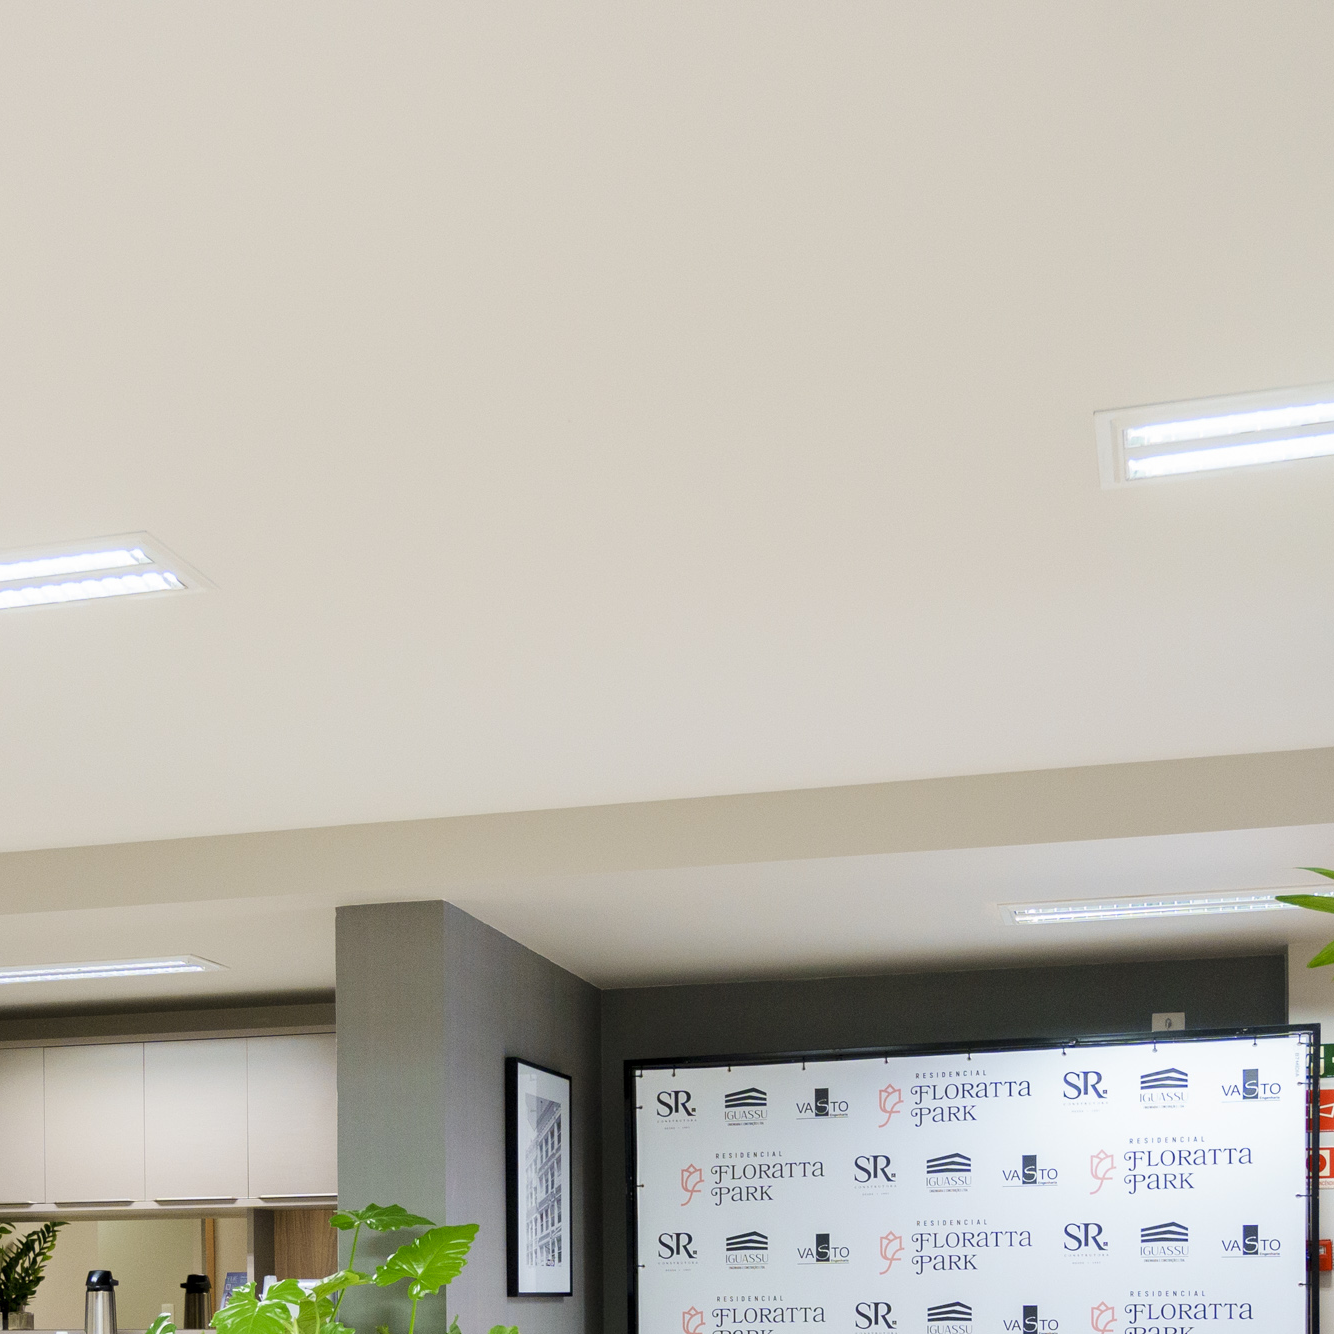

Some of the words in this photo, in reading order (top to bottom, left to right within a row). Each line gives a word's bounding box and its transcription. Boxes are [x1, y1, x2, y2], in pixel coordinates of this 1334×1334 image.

[916, 1070, 986, 1079] RESIDENCIAL
[1063, 1071, 1107, 1100] SR
[1221, 1081, 1281, 1096] VASTO
[657, 1090, 696, 1117] SR
[1140, 1092, 1189, 1103] IGUASSU
[796, 1099, 849, 1114] VASTO
[724, 1110, 767, 1120] IGUASSU
[1129, 1136, 1204, 1144] RESIDENCIAL
[716, 1151, 782, 1159] RESIDENCIAL
[854, 1155, 896, 1183] SR
[1002, 1167, 1058, 1182] VASTO
[926, 1176, 971, 1186] IGUASSU
[1064, 1223, 1108, 1251] SR
[658, 1232, 697, 1259] SR
[797, 1243, 850, 1259] VASTO
[1140, 1246, 1189, 1255] IGUASSU
[1221, 1238, 1281, 1253] VASTO
[726, 1254, 768, 1264] IGUASSU
[855, 1302, 897, 1329] SR
[927, 1325, 972, 1334] IGUASSU
[1003, 1317, 1059, 1332] VASTO
